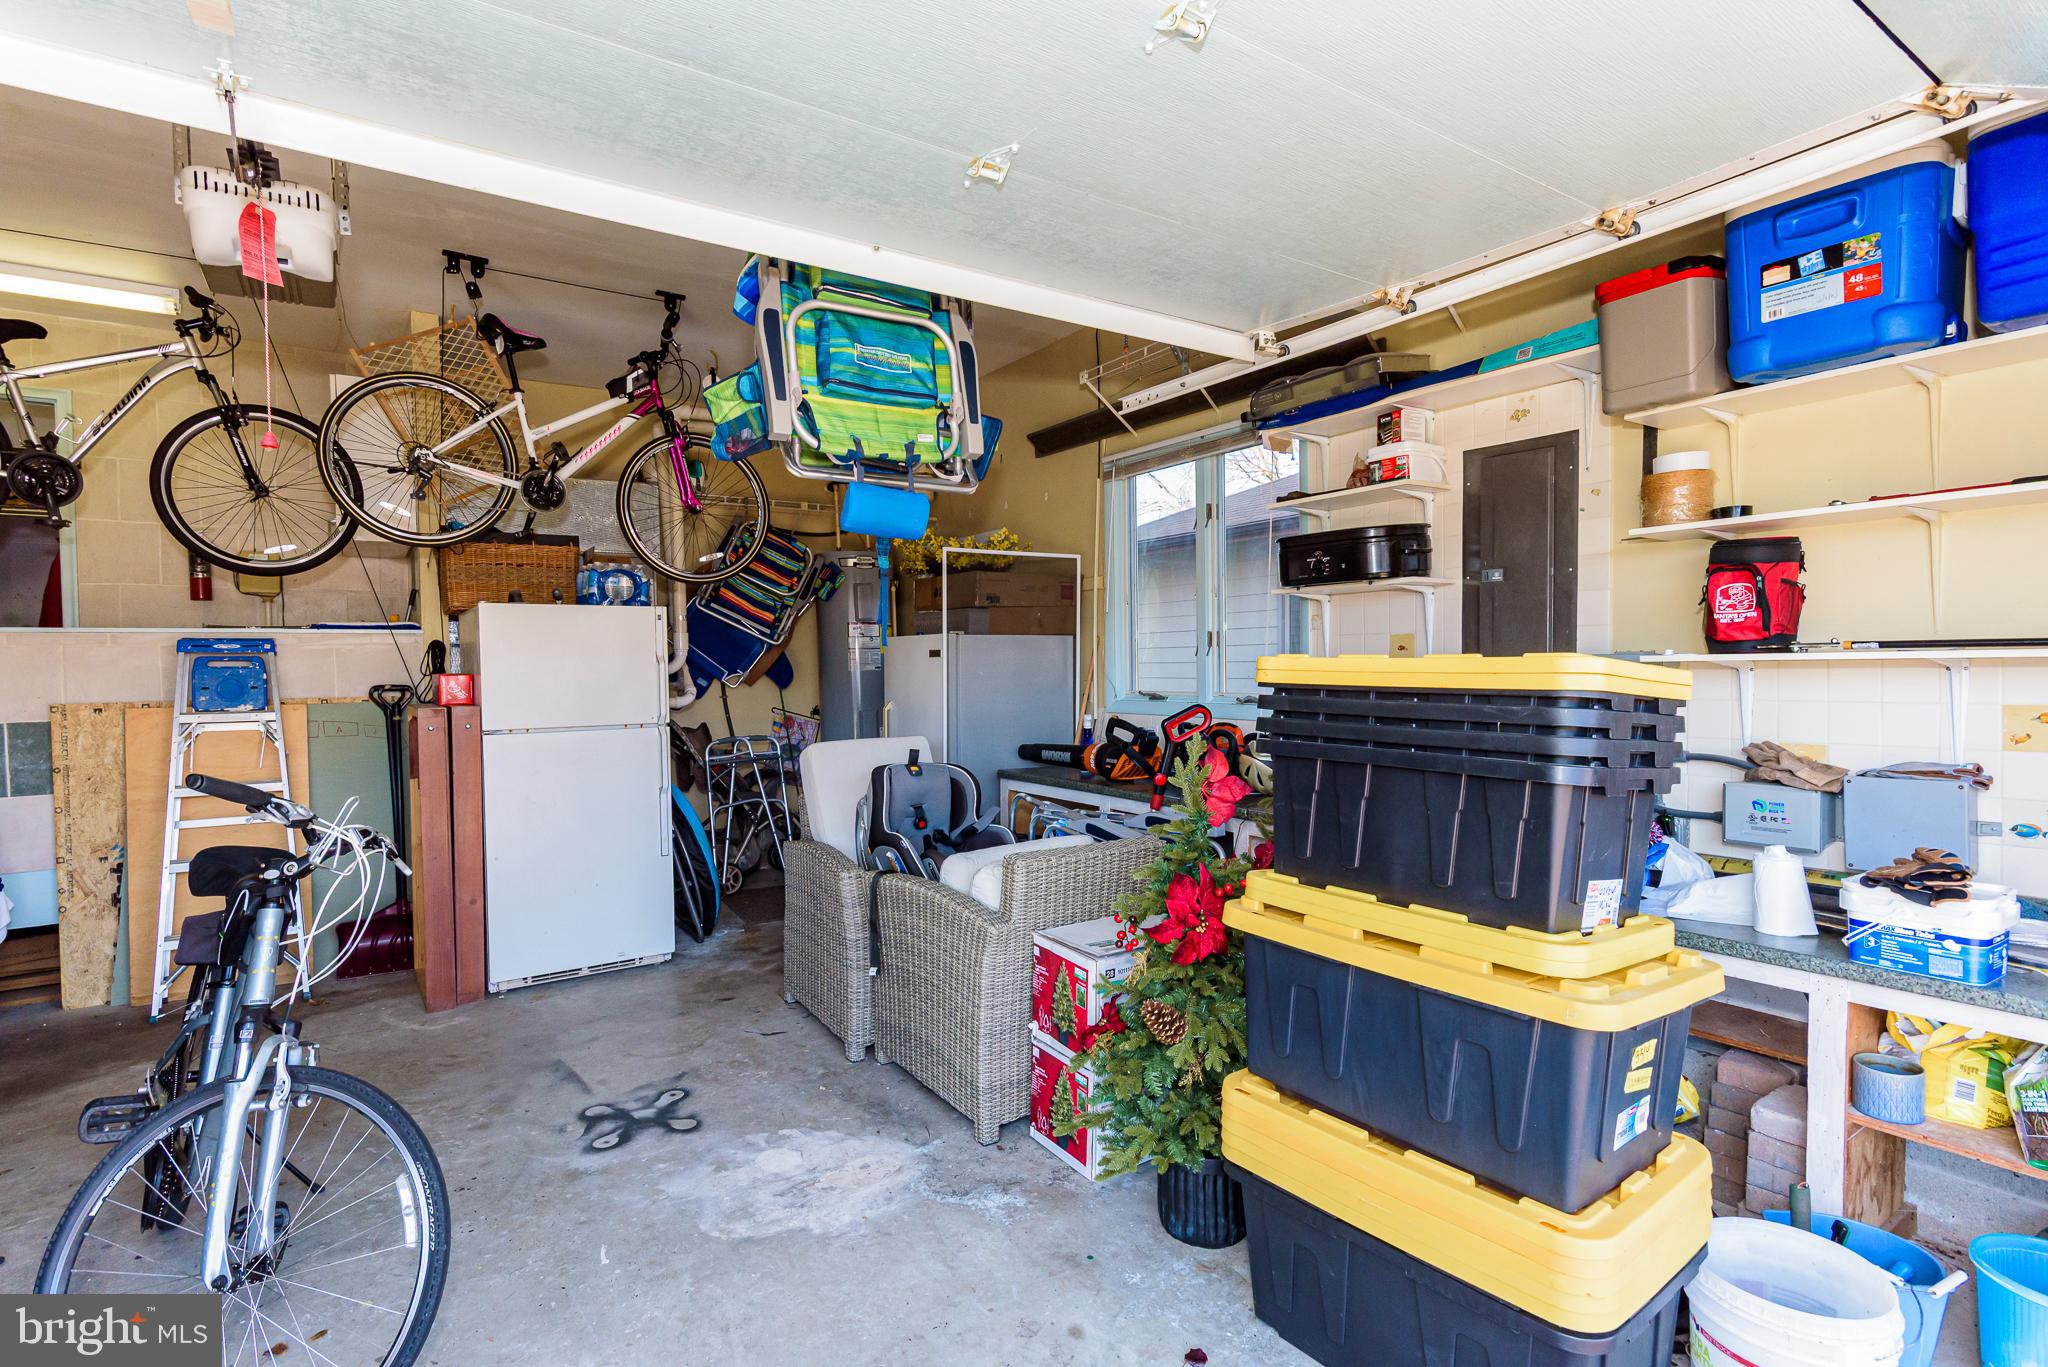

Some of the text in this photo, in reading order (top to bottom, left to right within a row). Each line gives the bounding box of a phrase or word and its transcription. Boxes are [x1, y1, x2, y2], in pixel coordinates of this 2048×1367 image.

[1848, 273, 1864, 284] 48
[1916, 929, 1936, 940] Tabs
[1106, 970, 1115, 979] 28
[2020, 1090, 2046, 1098] 3-IN-1
